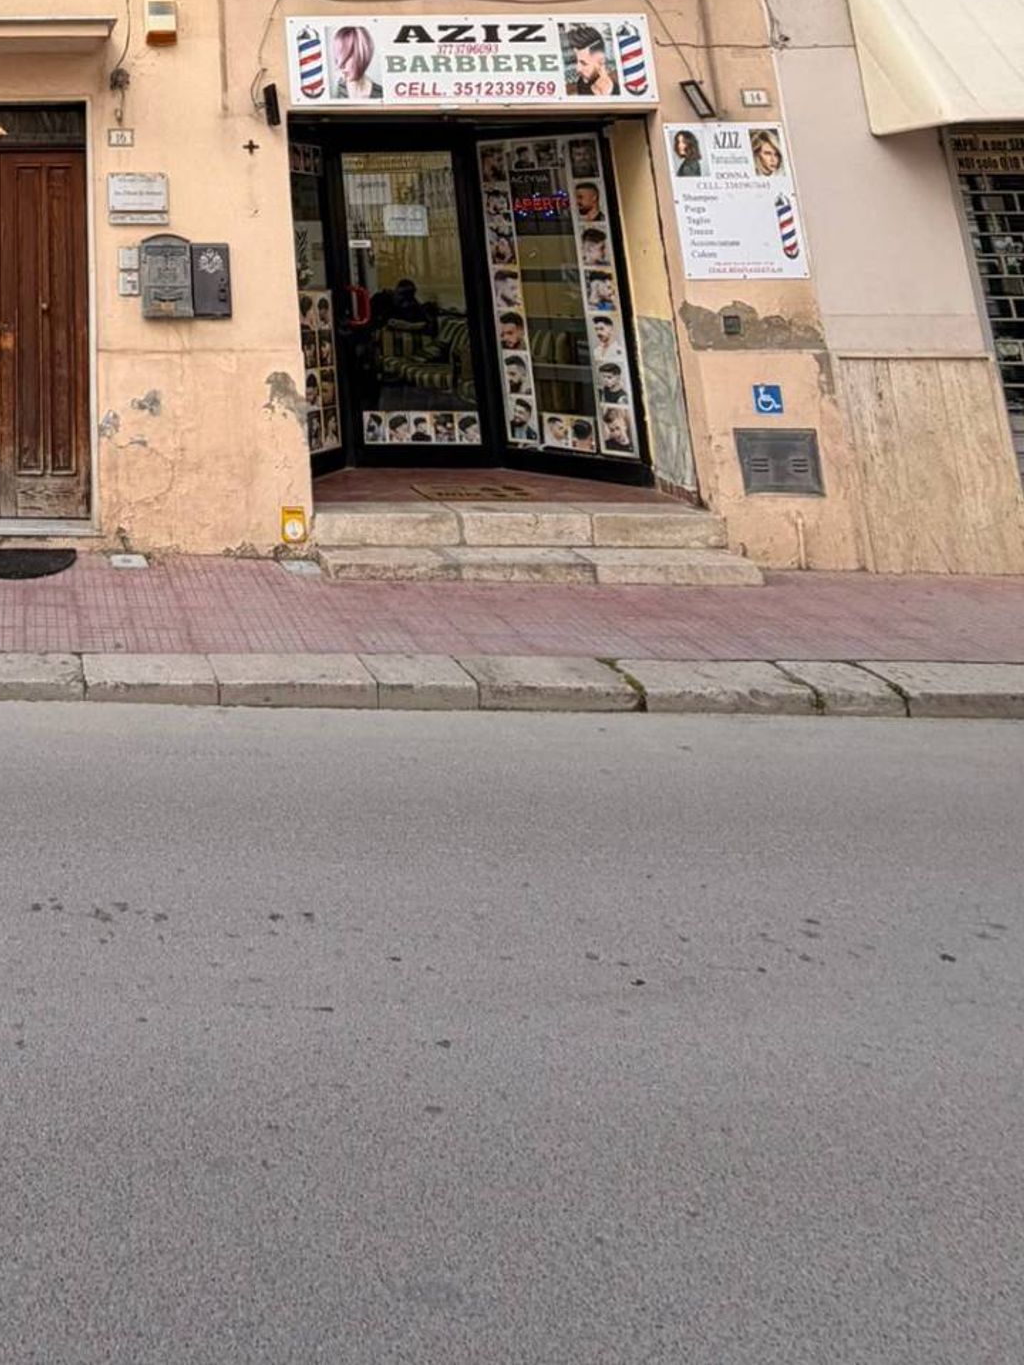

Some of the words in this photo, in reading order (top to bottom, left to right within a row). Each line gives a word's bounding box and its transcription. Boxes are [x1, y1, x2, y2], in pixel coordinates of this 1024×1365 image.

[393, 23, 547, 44] AZIZ
[385, 54, 560, 74] BARBIERE
[394, 82, 447, 97] CELL.
[453, 80, 557, 97] 3512339769
[713, 131, 743, 150] AZIZ
[716, 172, 750, 180] DONNA
